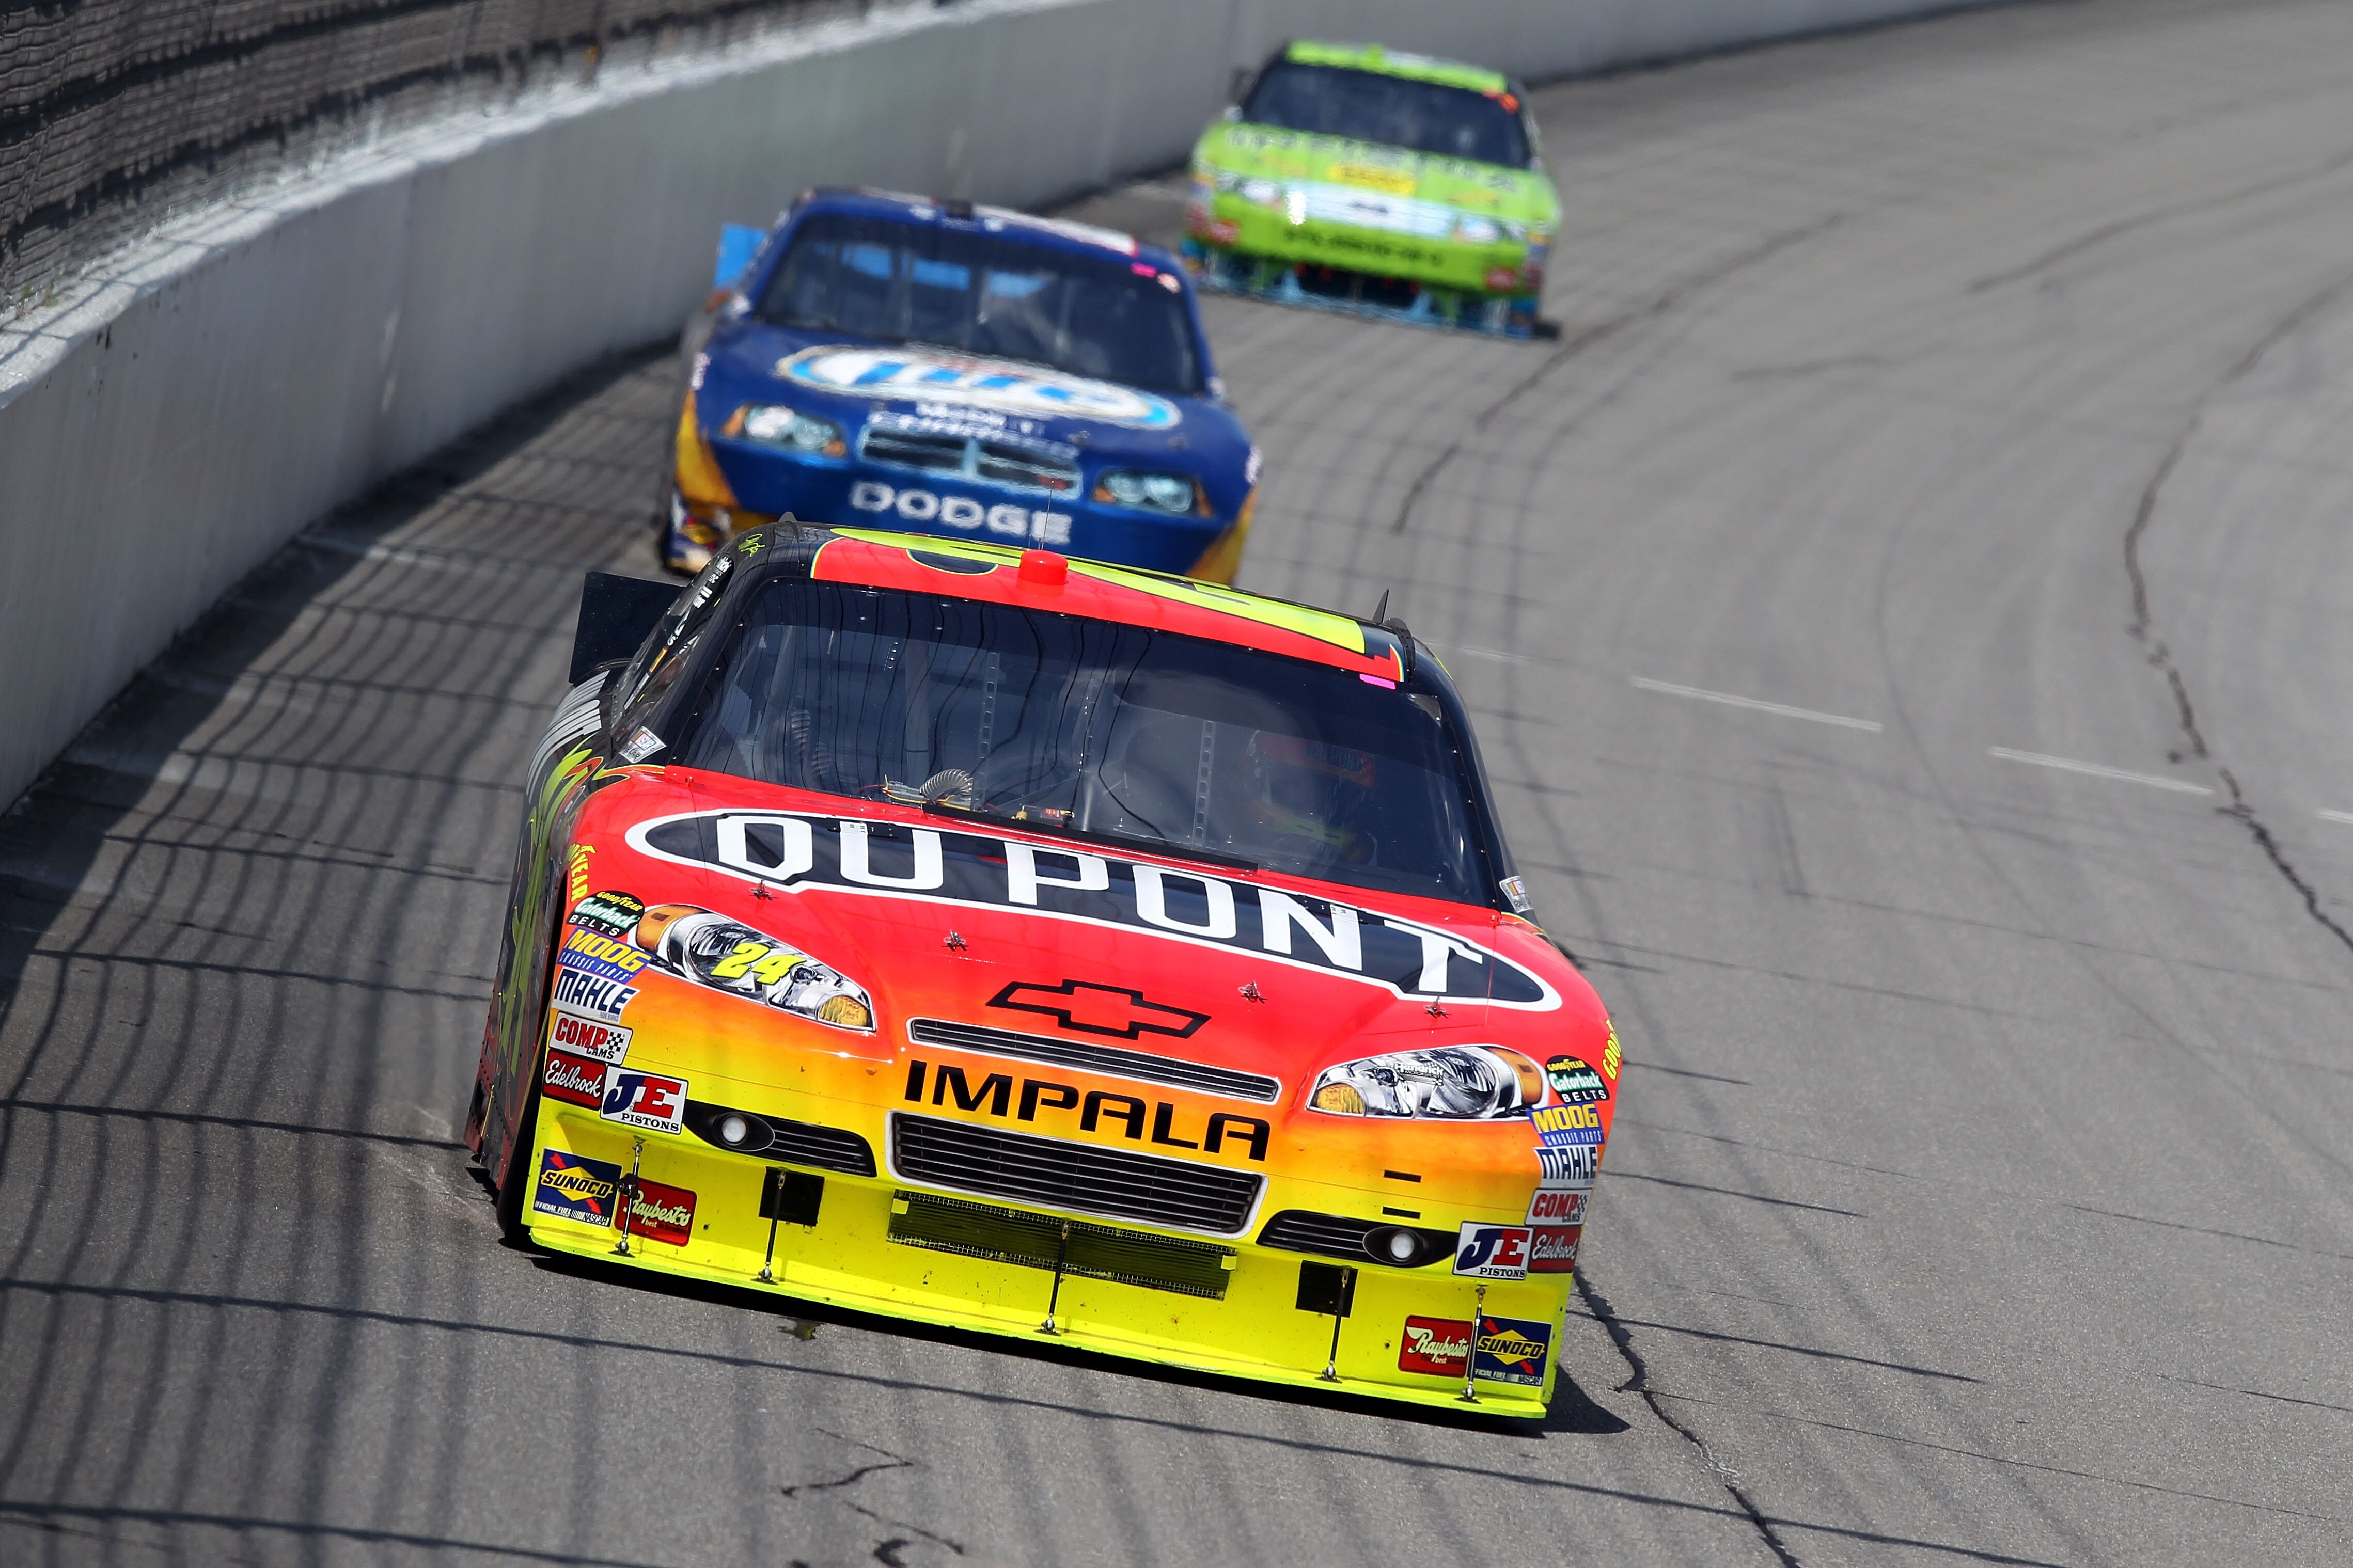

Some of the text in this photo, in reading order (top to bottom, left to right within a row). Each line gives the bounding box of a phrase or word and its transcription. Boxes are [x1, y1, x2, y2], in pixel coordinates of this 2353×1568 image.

[851, 481, 1072, 544] DODGE
[574, 897, 639, 929] Gatorback
[597, 892, 643, 911] GOODYEAR
[569, 915, 620, 936] BELTS
[564, 929, 652, 972] MOOG
[559, 952, 629, 981] CHASSIS PARTS
[711, 943, 806, 985] 24
[554, 969, 636, 1015] MAHLE
[555, 1018, 608, 1049] COMP
[586, 1046, 615, 1059] CAMS
[1547, 1059, 1586, 1071] GOODYEAR
[545, 1059, 603, 1097] Edelbrock
[1394, 1063, 1444, 1076] Hendrick
[1549, 1071, 1603, 1092] Gatorback
[603, 1074, 682, 1119] JE
[1562, 1090, 1607, 1102] BELTS
[621, 1113, 679, 1132] PISTONS
[904, 1060, 1270, 1161] IMPALA
[1532, 1104, 1599, 1134] MOOG
[1545, 1130, 1601, 1145] CHASSIS PARTS
[1536, 1147, 1597, 1179] MAHLE
[543, 1171, 610, 1197] SUNOCO
[557, 1206, 571, 1214] FUEL
[1533, 1194, 1578, 1217] COMP
[1562, 1214, 1580, 1222] CAMS
[1456, 1228, 1529, 1270] JE
[1532, 1234, 1577, 1260] Edelbrock
[1479, 1267, 1525, 1277] PISTONS
[1406, 1326, 1469, 1362] Raybestos
[1478, 1338, 1543, 1357] SUNOCO
